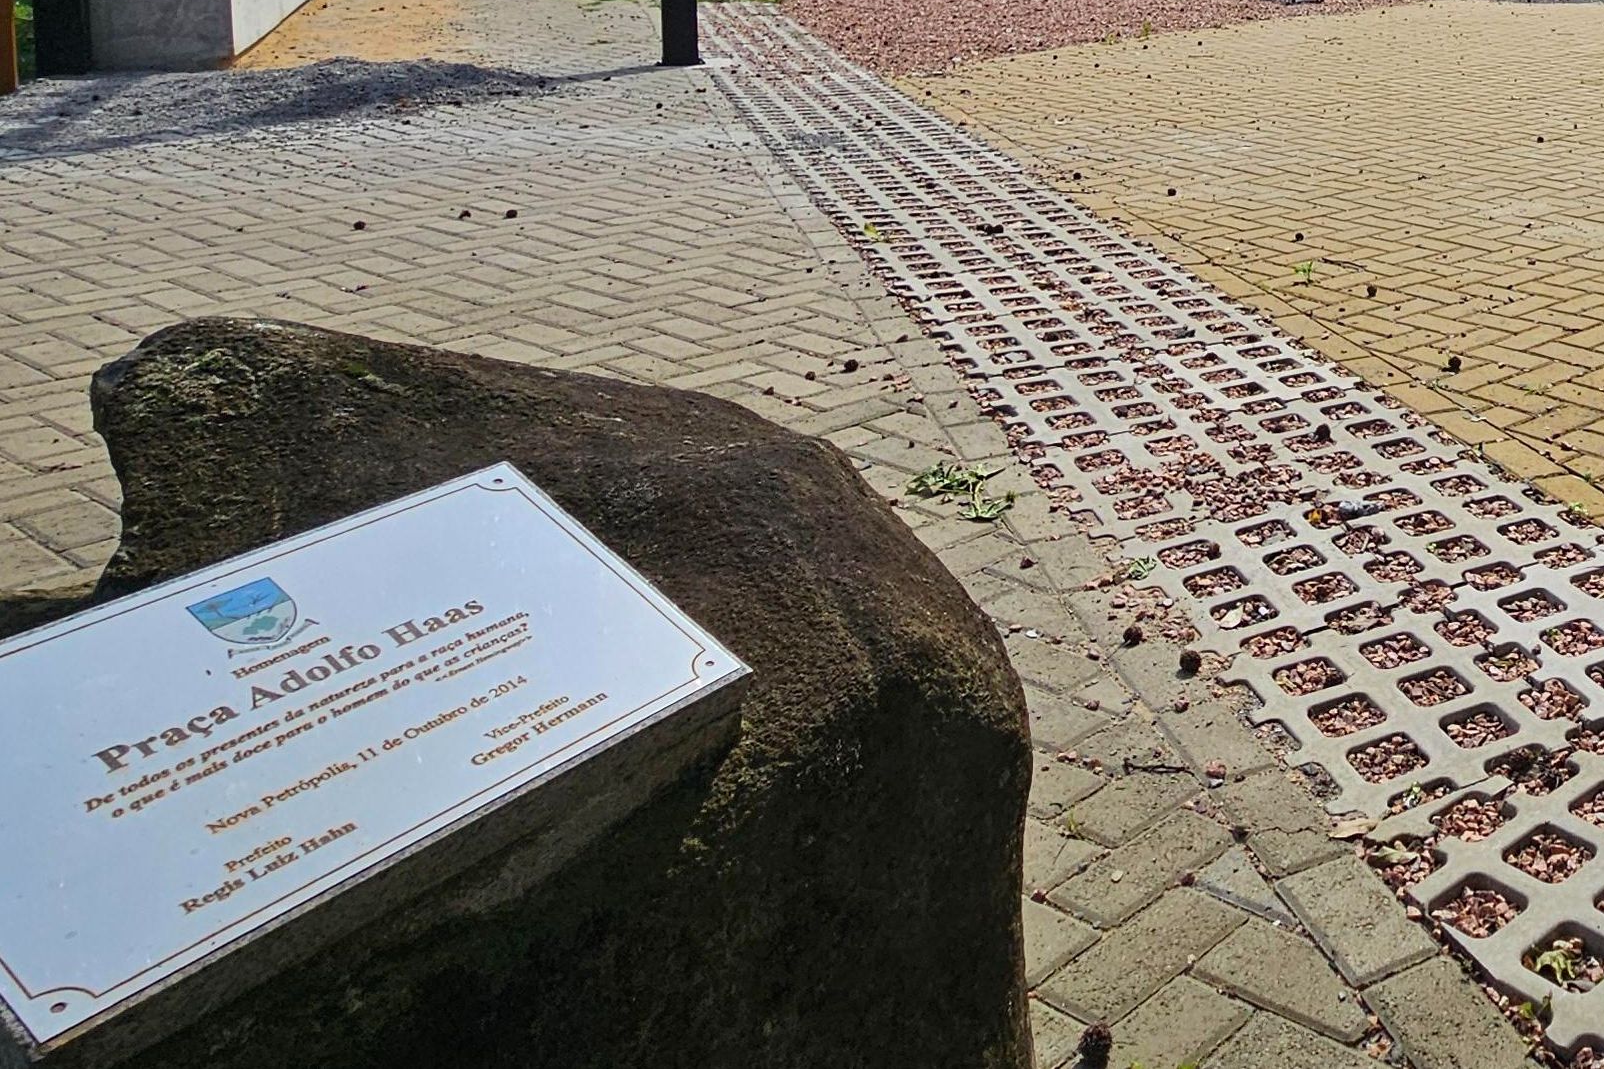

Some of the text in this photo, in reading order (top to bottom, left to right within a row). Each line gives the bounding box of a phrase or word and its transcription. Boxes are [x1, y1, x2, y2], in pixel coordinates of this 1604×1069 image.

[90, 599, 485, 774] Praça Adolfo Haas
[231, 636, 332, 679] Homenagem
[84, 611, 530, 812] De todos os presentes da natureza para a raça humana,
[112, 808, 124, 818] o
[130, 789, 166, 812] que
[170, 779, 181, 791] é
[185, 761, 229, 784] mais
[232, 740, 272, 763] doce
[274, 722, 314, 747] para
[317, 715, 328, 724] o
[330, 689, 388, 718] homem
[392, 678, 410, 691] do
[414, 664, 440, 682] que
[444, 656, 460, 667] as
[205, 675, 527, 834] Nova Petrópolis, 11 de Outubro de 2014
[470, 692, 608, 766] Gregor Hermann
[483, 695, 570, 740] Vice-Prefeito
[179, 822, 358, 915] Regis Luiz Hahn
[223, 836, 292, 873] Prefeito
